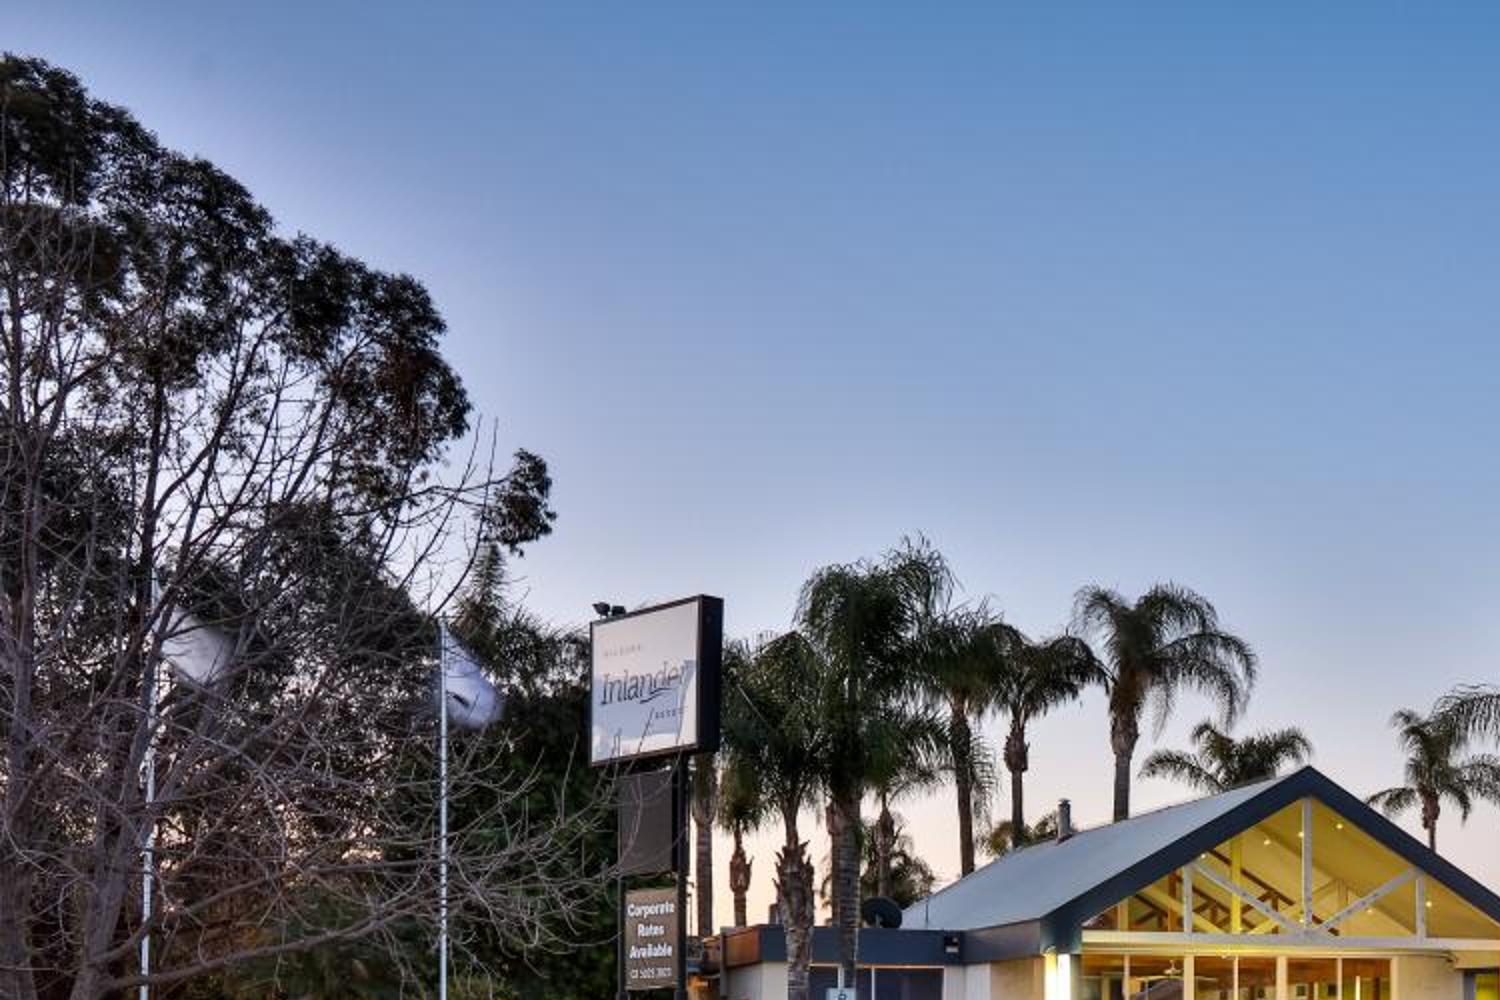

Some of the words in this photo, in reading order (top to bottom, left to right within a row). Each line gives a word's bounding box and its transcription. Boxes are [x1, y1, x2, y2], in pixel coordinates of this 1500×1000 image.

[601, 660, 690, 705] Inlander
[627, 901, 675, 918] Corporate
[638, 923, 665, 937] Rates
[629, 943, 673, 959] Available
